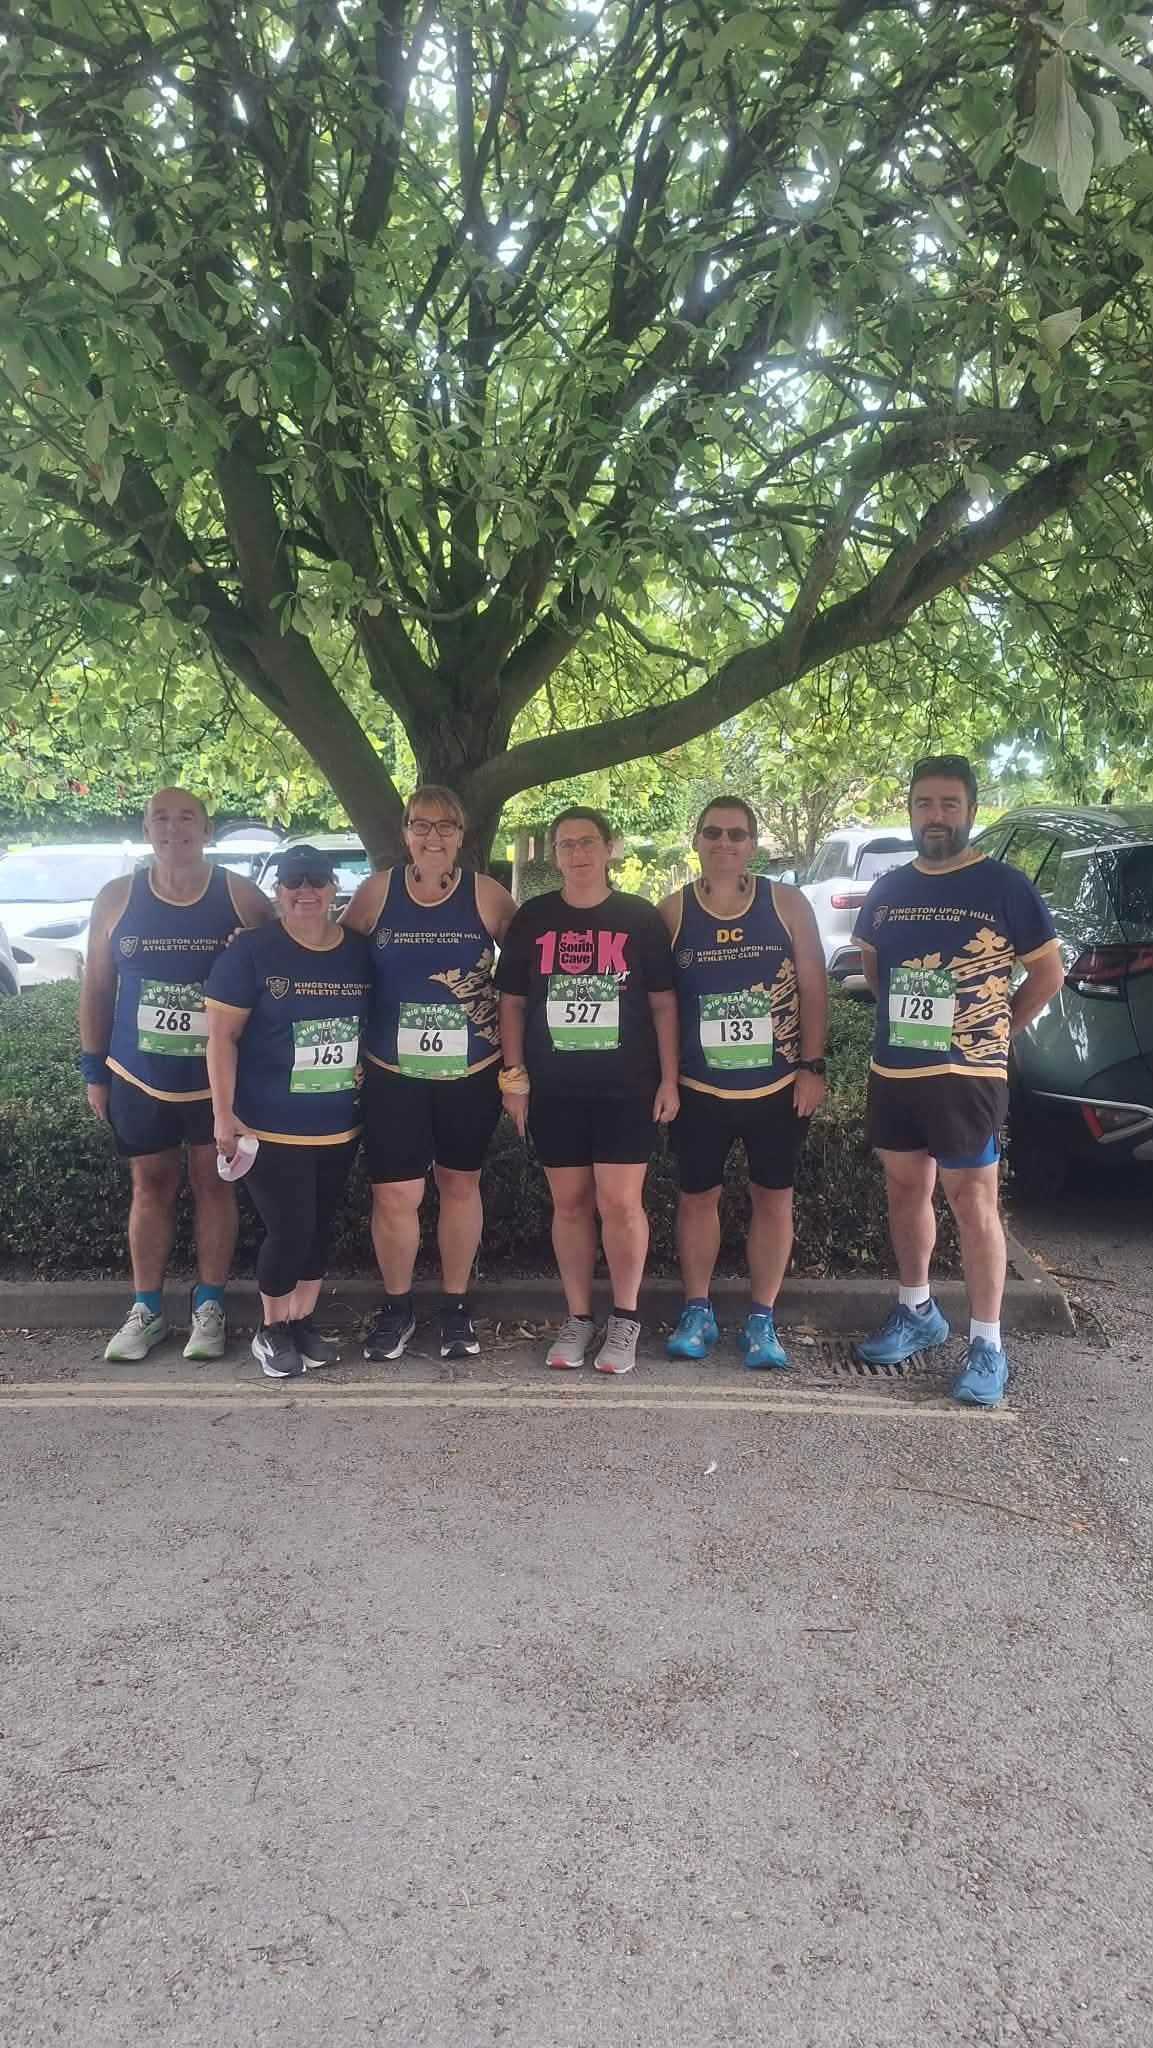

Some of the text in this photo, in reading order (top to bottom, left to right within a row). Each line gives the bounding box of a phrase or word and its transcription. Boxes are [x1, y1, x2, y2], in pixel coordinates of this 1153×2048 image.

[888, 914, 961, 922] ATHLETIC CLUB
[889, 907, 997, 922] KINGSTON UPON HULL
[716, 927, 744, 943] DC
[143, 944, 215, 952] ATHLETIC CLUB
[559, 942, 594, 953] South
[697, 948, 739, 957] KINGSTON
[561, 953, 590, 964] Cave
[698, 954, 736, 962] ATHLETIC
[572, 977, 593, 985] BEAR
[596, 980, 613, 991] RUN
[747, 997, 764, 1008] RUN
[900, 996, 934, 1021] 128
[421, 1006, 442, 1014] BEAR
[444, 1008, 461, 1020] RUN
[565, 1003, 602, 1023] 527
[155, 1010, 191, 1032] 268
[720, 1020, 754, 1042] 133
[419, 1031, 444, 1052] 66
[313, 1045, 344, 1065] 163
